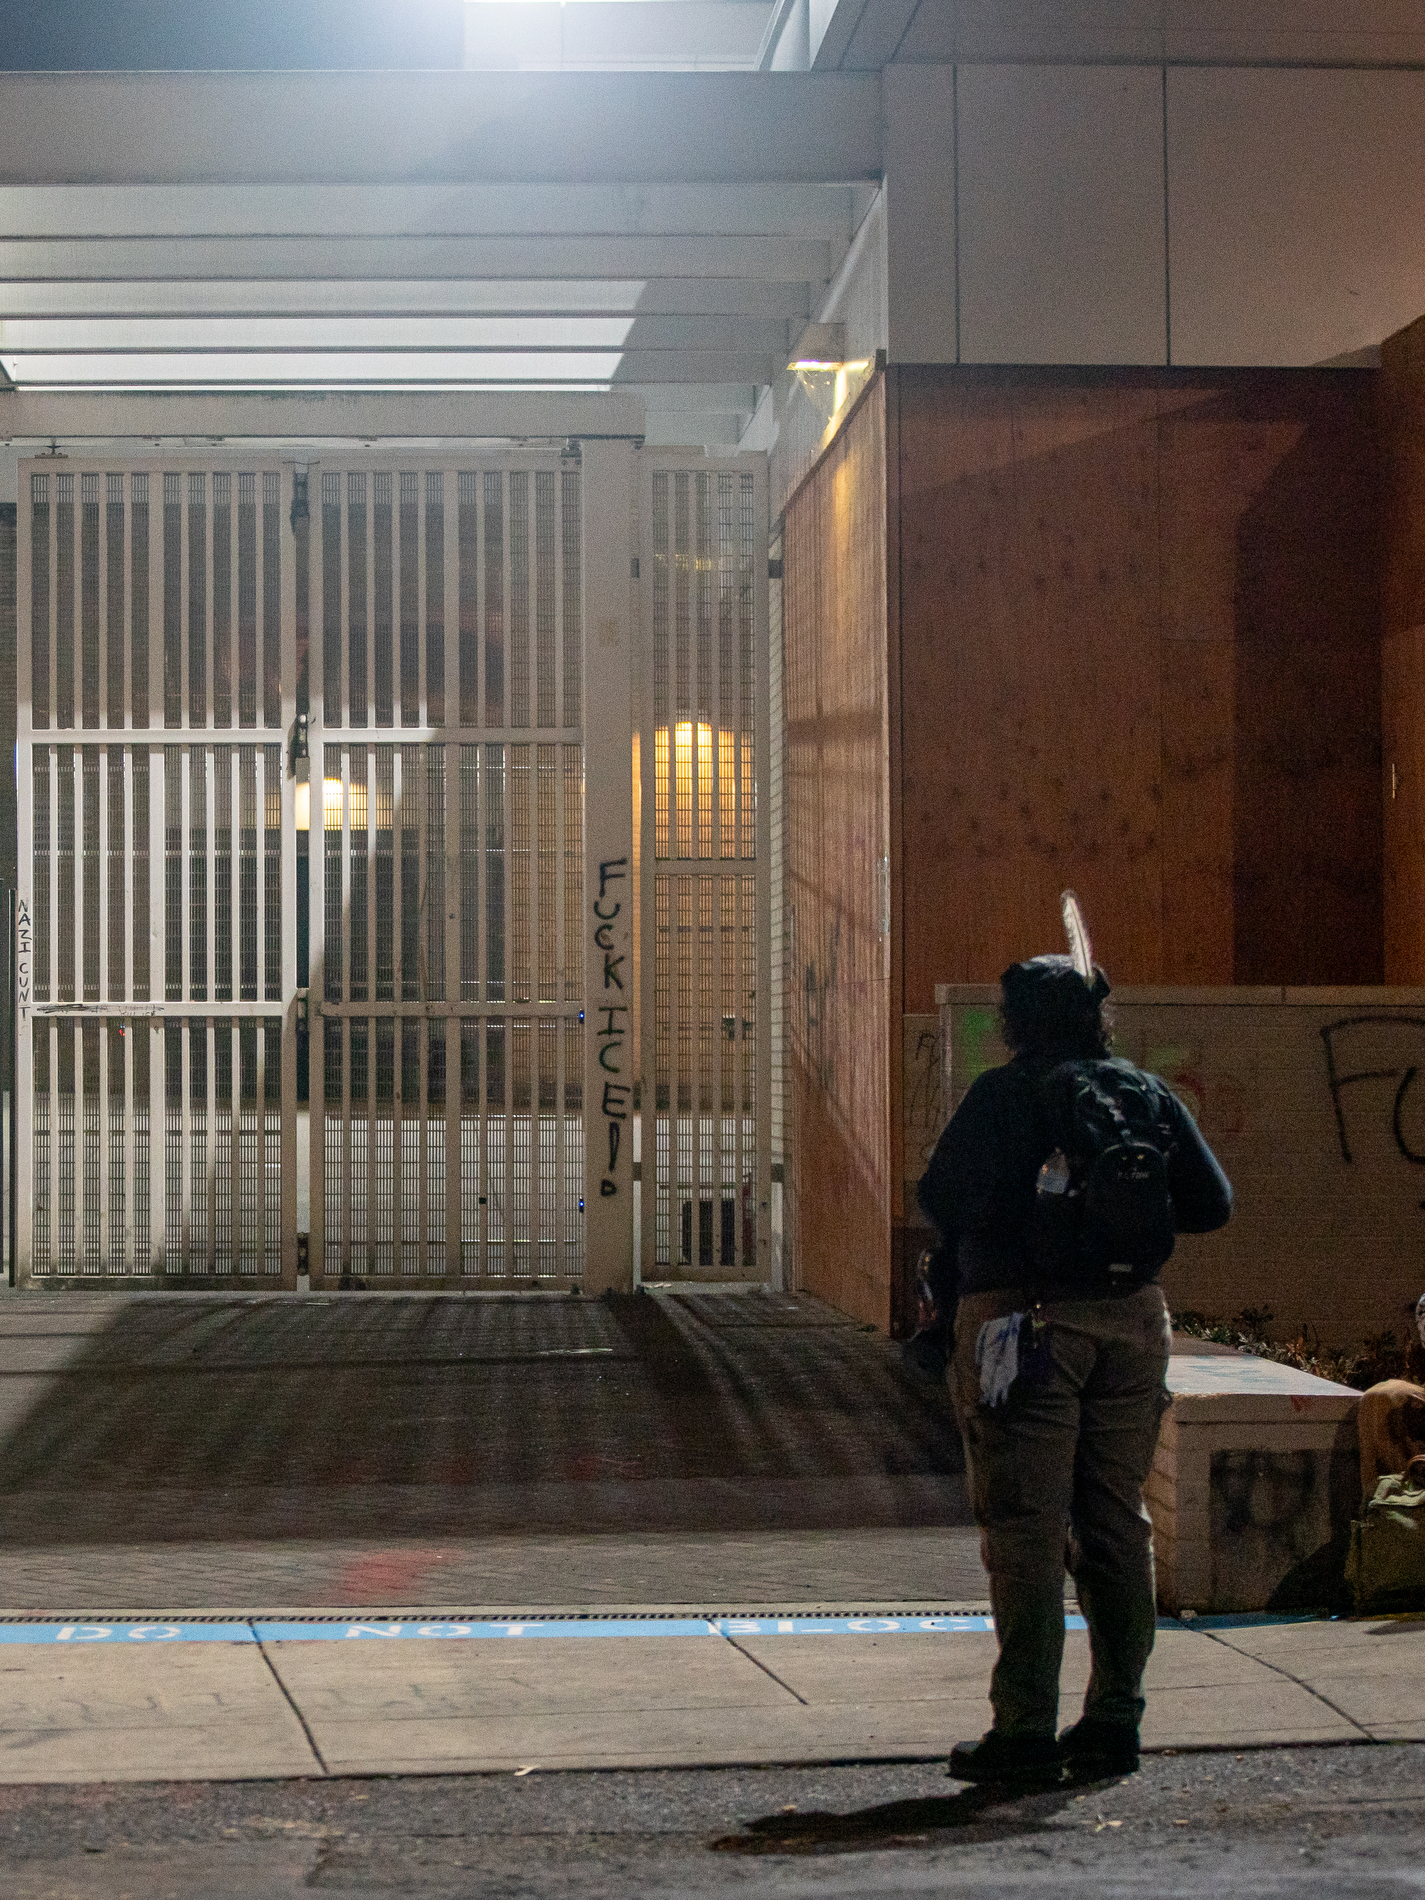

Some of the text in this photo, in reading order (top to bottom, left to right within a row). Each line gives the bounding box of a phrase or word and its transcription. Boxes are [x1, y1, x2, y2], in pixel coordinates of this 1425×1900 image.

[18, 899, 32, 1022] NAZI CUNT
[593, 857, 631, 1197] FUCK ICE!
[55, 1625, 182, 1641] DO
[344, 1622, 544, 1638] NOT
[707, 1617, 997, 1634] BLOC
